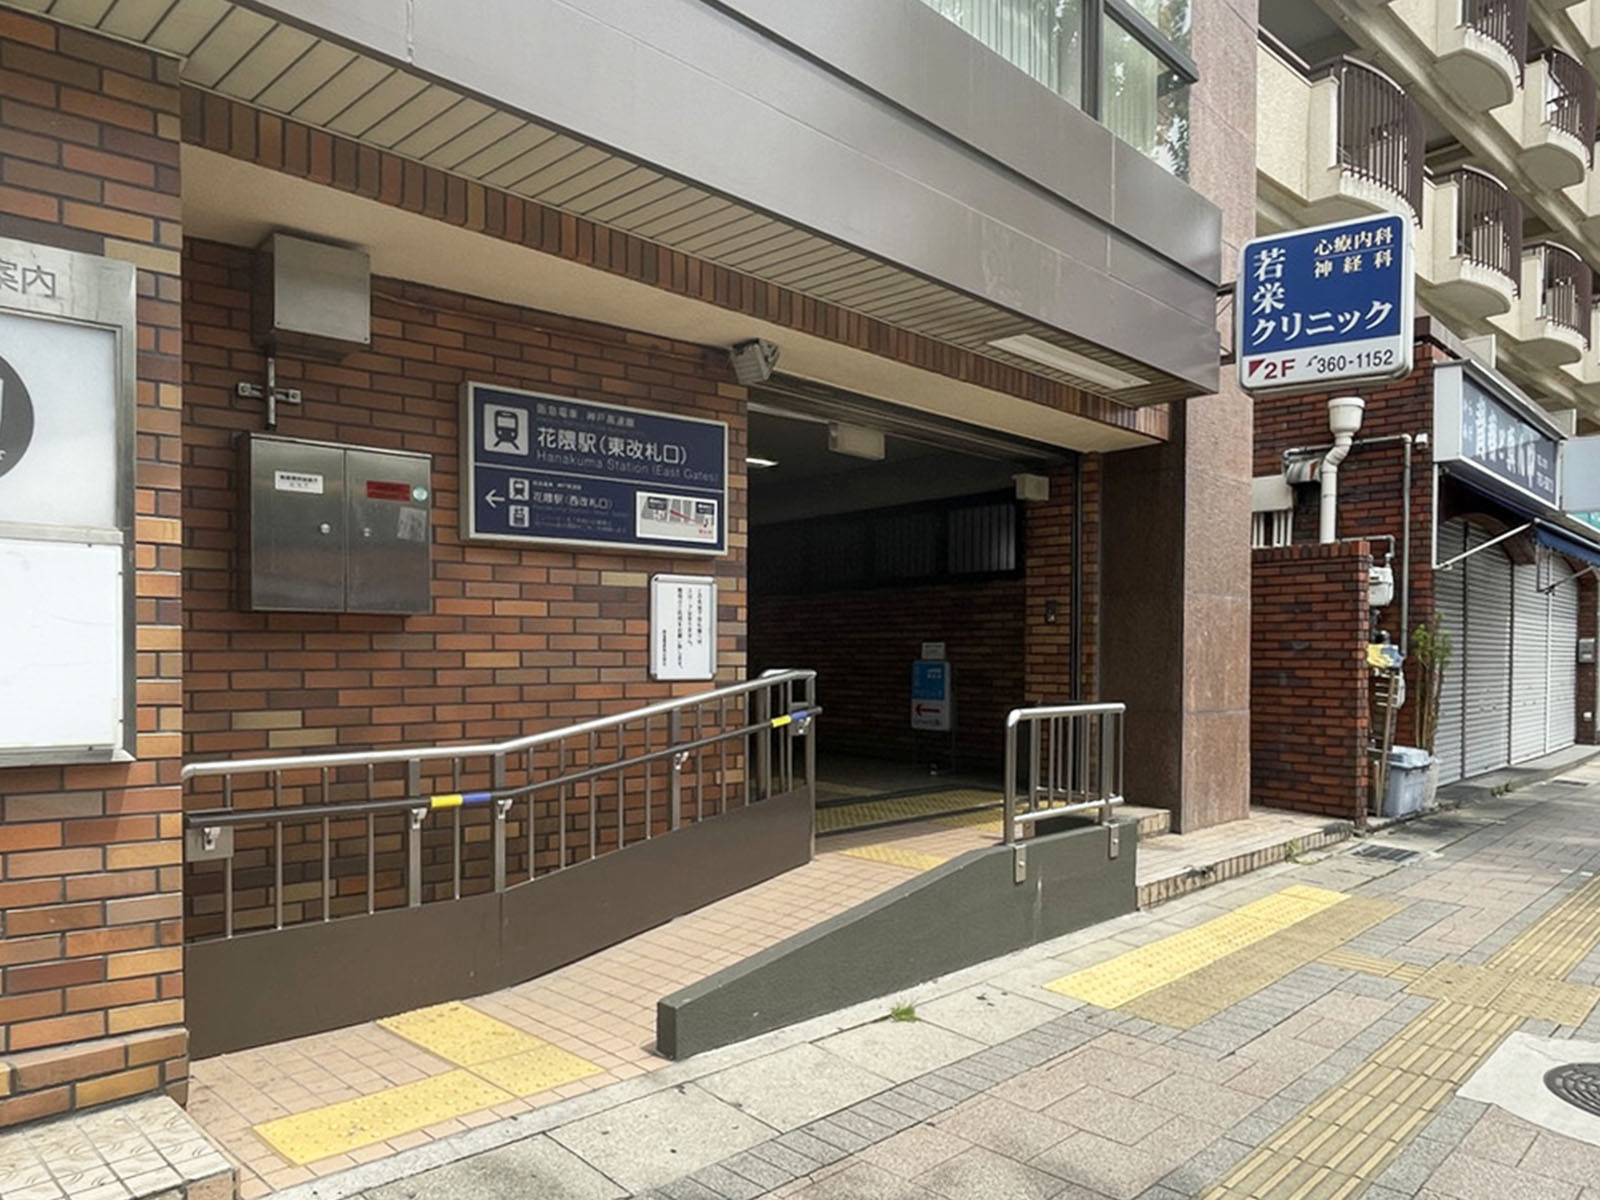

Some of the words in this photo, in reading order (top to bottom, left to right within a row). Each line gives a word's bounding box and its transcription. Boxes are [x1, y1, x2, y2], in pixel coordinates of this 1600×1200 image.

[1314, 227, 1394, 256] 心療内科
[1314, 249, 1393, 278] 神経科
[1251, 247, 1288, 315] 若栄
[1251, 300, 1393, 346] クリニック
[1264, 358, 1296, 380] 2F
[1317, 349, 1394, 374] 360-1152
[537, 449, 603, 469] Hanakuma
[607, 457, 648, 474] Station
